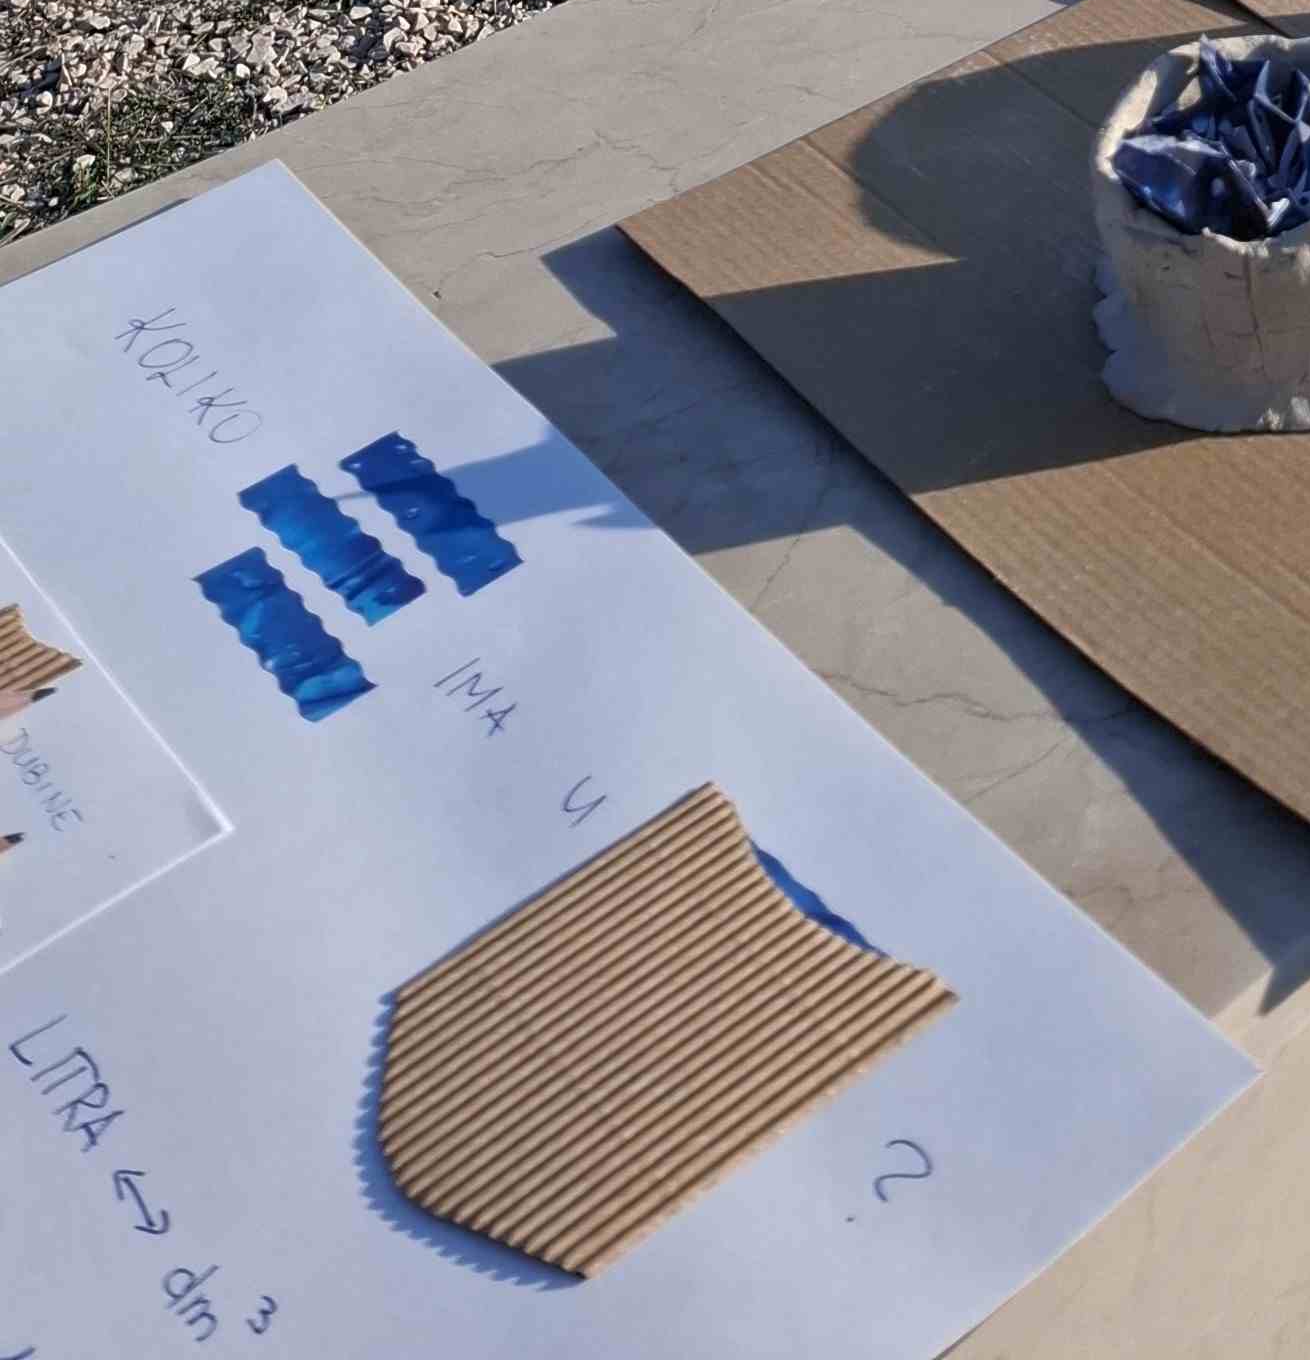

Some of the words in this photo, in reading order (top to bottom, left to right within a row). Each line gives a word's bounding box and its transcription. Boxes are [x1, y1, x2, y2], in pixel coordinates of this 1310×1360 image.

[113, 306, 264, 445] KOLIKO
[432, 655, 519, 738] IMA
[9, 1013, 127, 1153] LITRA
